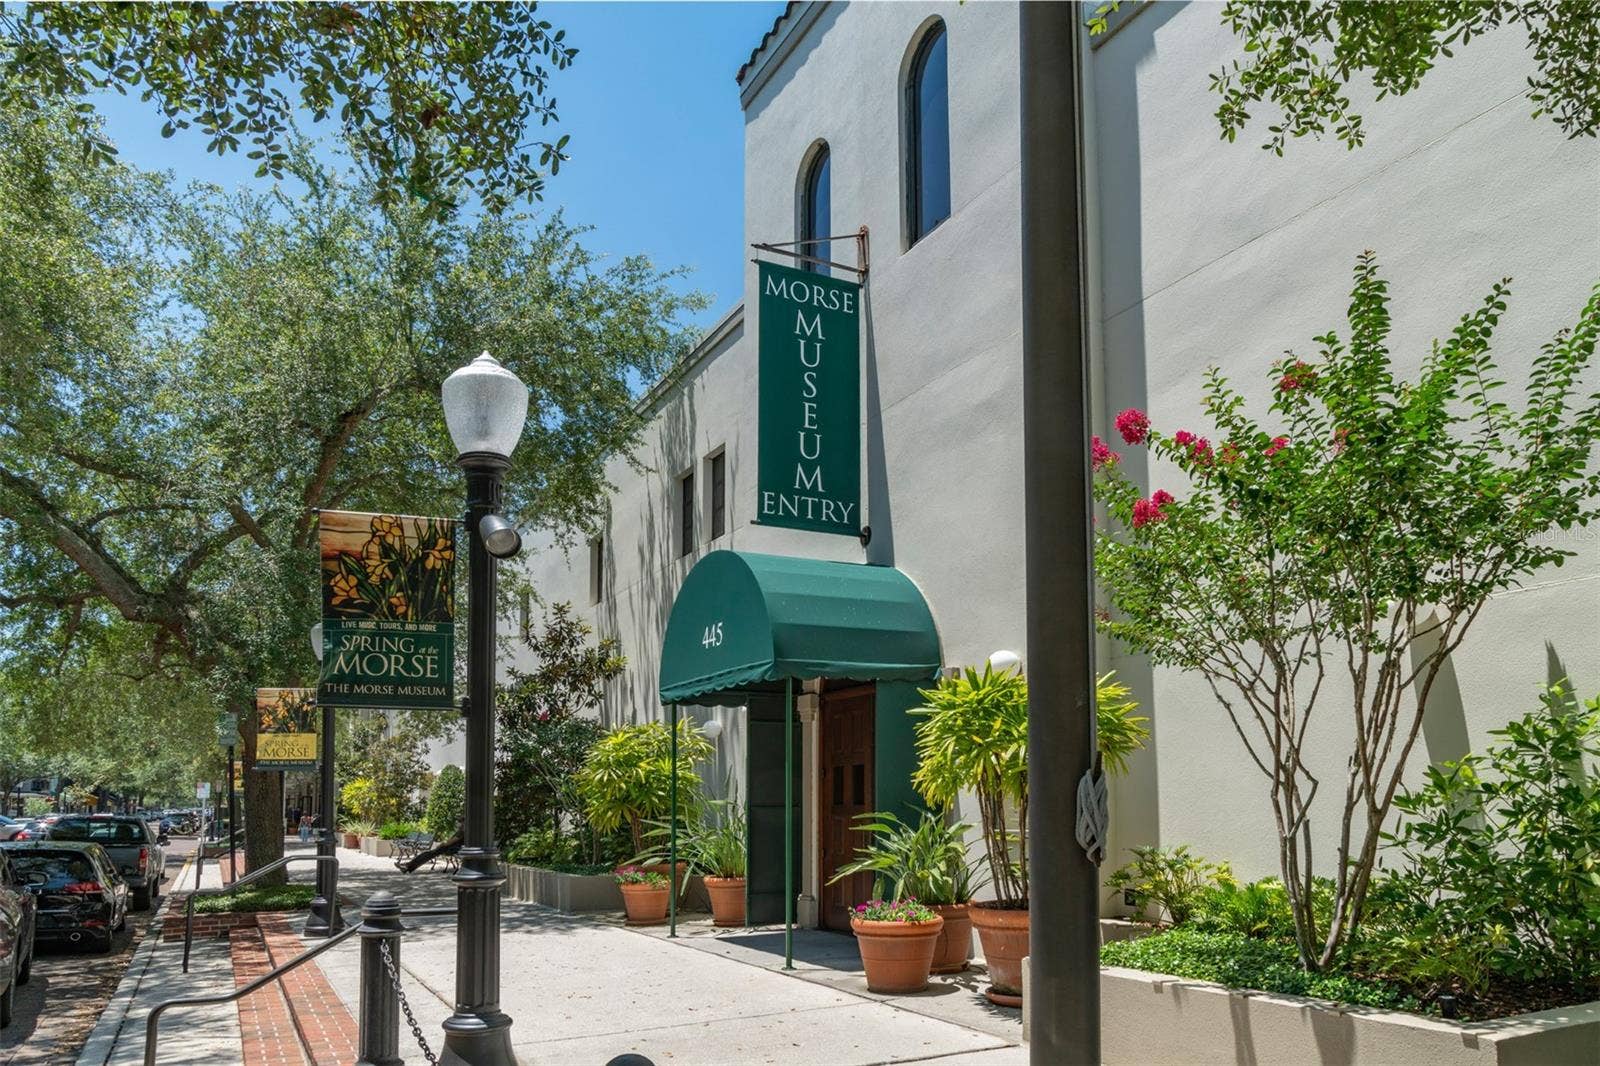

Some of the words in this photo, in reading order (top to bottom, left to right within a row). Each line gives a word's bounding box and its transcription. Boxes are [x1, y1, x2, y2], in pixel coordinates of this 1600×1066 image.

[765, 274, 854, 314] MORSE
[793, 308, 826, 493] MUSEUM
[762, 490, 855, 524] ENTRY
[341, 621, 357, 629] LIVE
[404, 623, 417, 631] AND
[419, 624, 437, 632] MORE
[702, 621, 723, 649] 445
[340, 634, 415, 653] SPRING
[333, 651, 439, 678] MORSE
[325, 682, 350, 694] THE
[353, 684, 394, 695] MORSE
[397, 686, 446, 696] MUSEUM
[263, 747, 310, 758] MORSE
